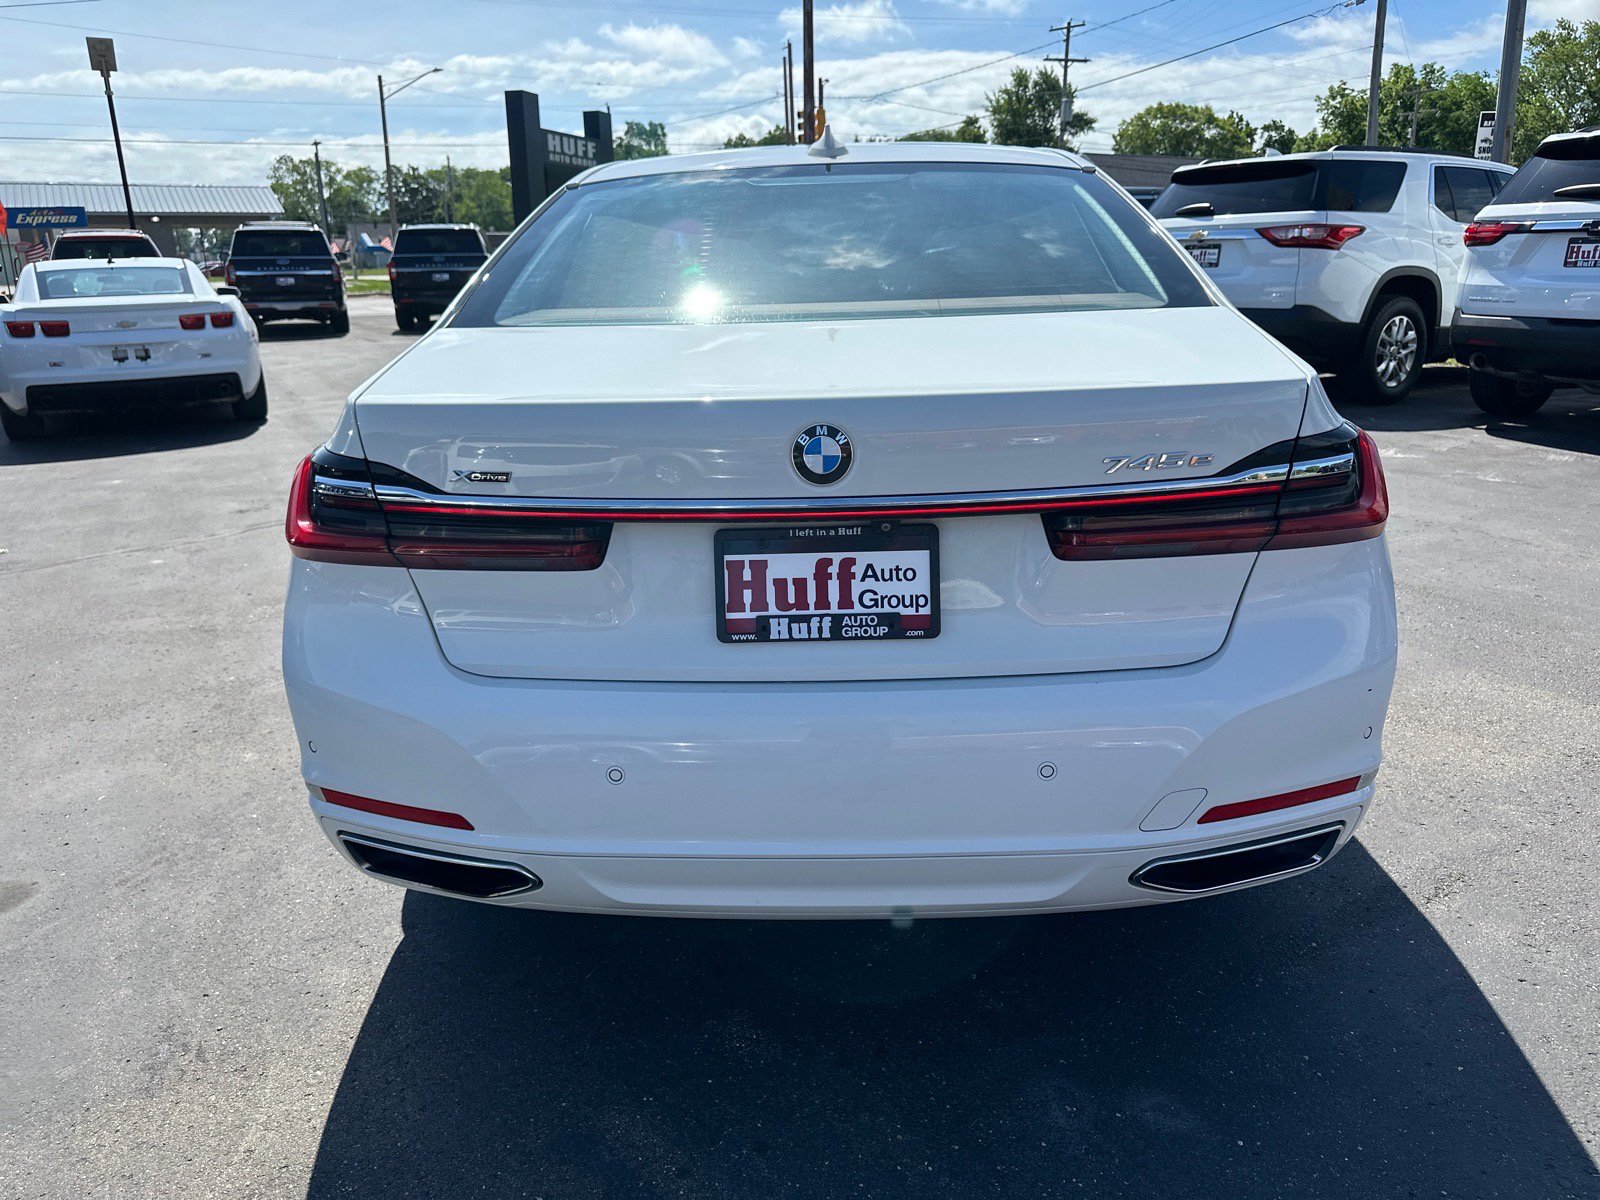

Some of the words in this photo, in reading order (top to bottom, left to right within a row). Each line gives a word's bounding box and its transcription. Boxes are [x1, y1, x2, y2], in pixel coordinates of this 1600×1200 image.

[547, 133, 596, 158] HUFF
[15, 213, 77, 226] Express
[1567, 245, 1600, 260] Huf
[797, 425, 848, 446] BMW
[795, 528, 814, 537] left
[816, 528, 826, 536] in
[838, 526, 862, 535] Huff
[860, 563, 917, 583] Auto
[725, 557, 857, 613] Huff
[858, 589, 929, 613] Group
[769, 617, 832, 640] Huff
[842, 615, 878, 626] AUTO
[842, 626, 888, 637] GROUP
[905, 629, 924, 637] .com
